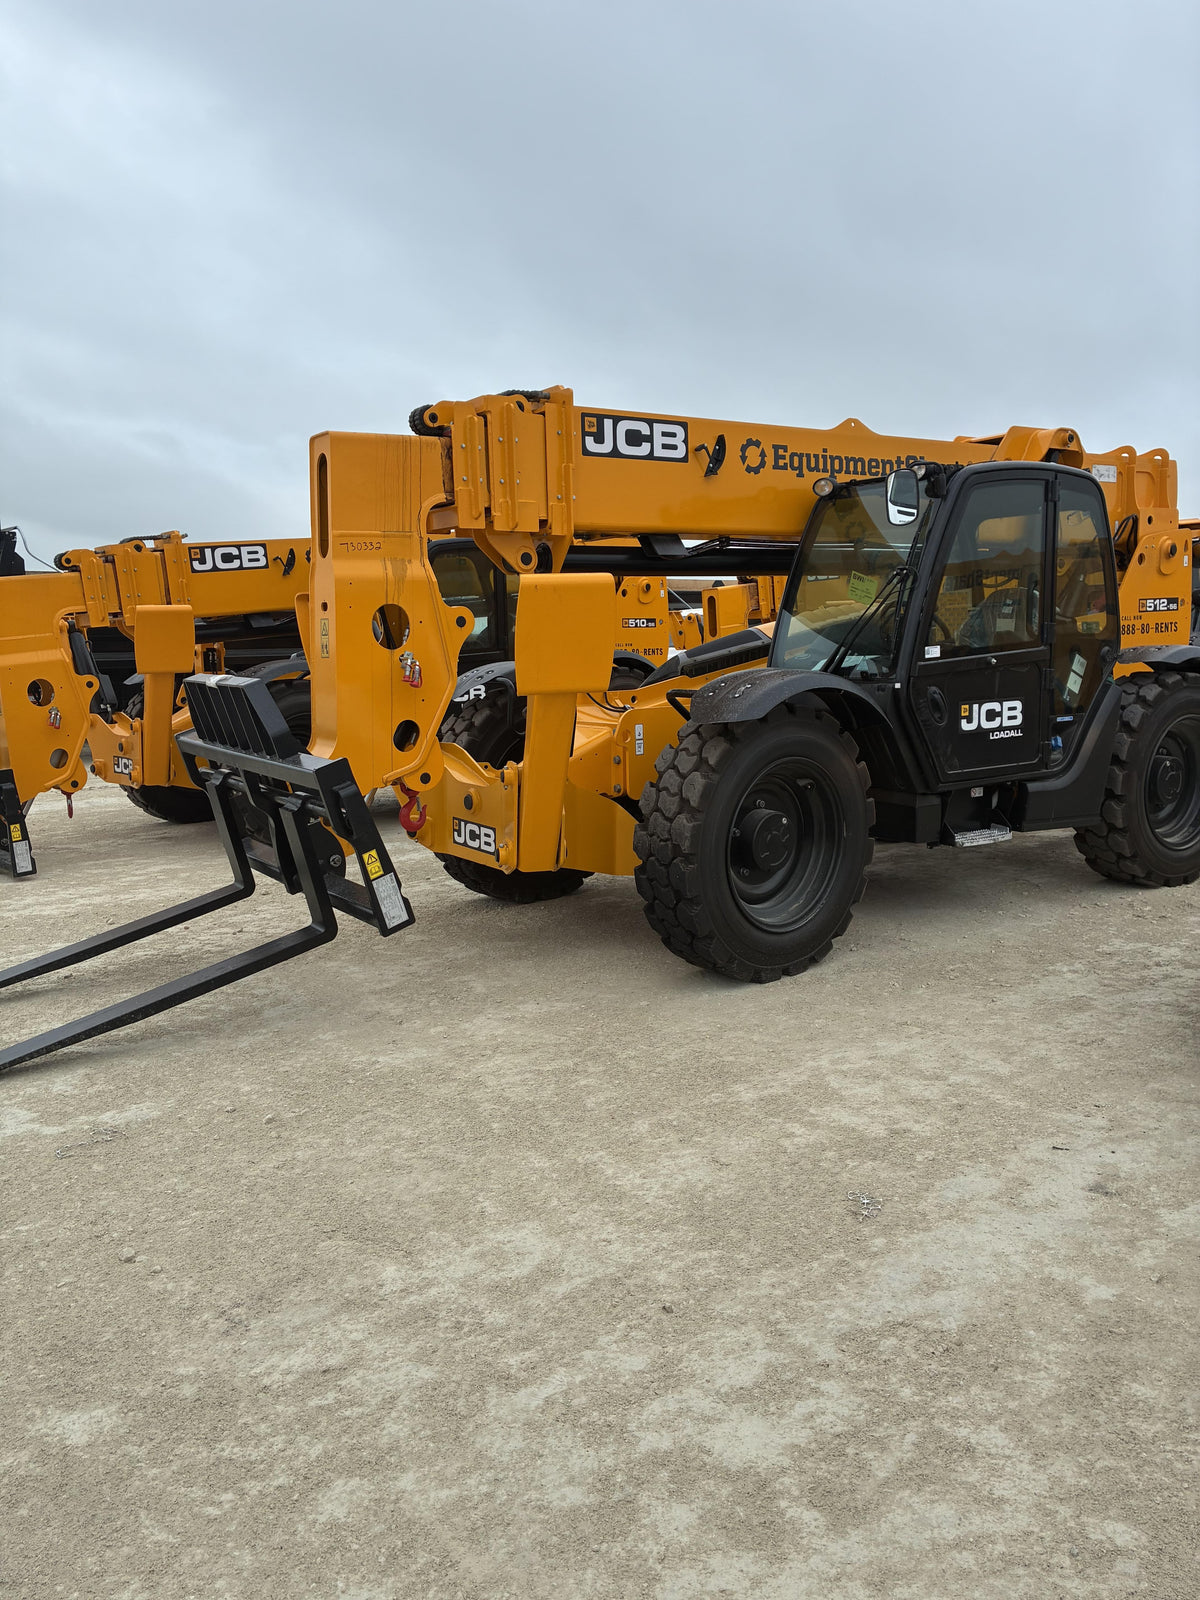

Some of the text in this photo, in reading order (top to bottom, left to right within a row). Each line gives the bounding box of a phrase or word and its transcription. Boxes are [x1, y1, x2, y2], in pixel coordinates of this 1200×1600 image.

[585, 418, 686, 459] JCB
[772, 444, 945, 480] Equipment
[192, 545, 267, 571] JCB
[339, 541, 382, 552] 730332
[1121, 621, 1178, 635] 888-80-RENTS
[960, 700, 1023, 731] JCB
[989, 729, 1023, 740] LOADALL
[453, 821, 496, 853] JCB
